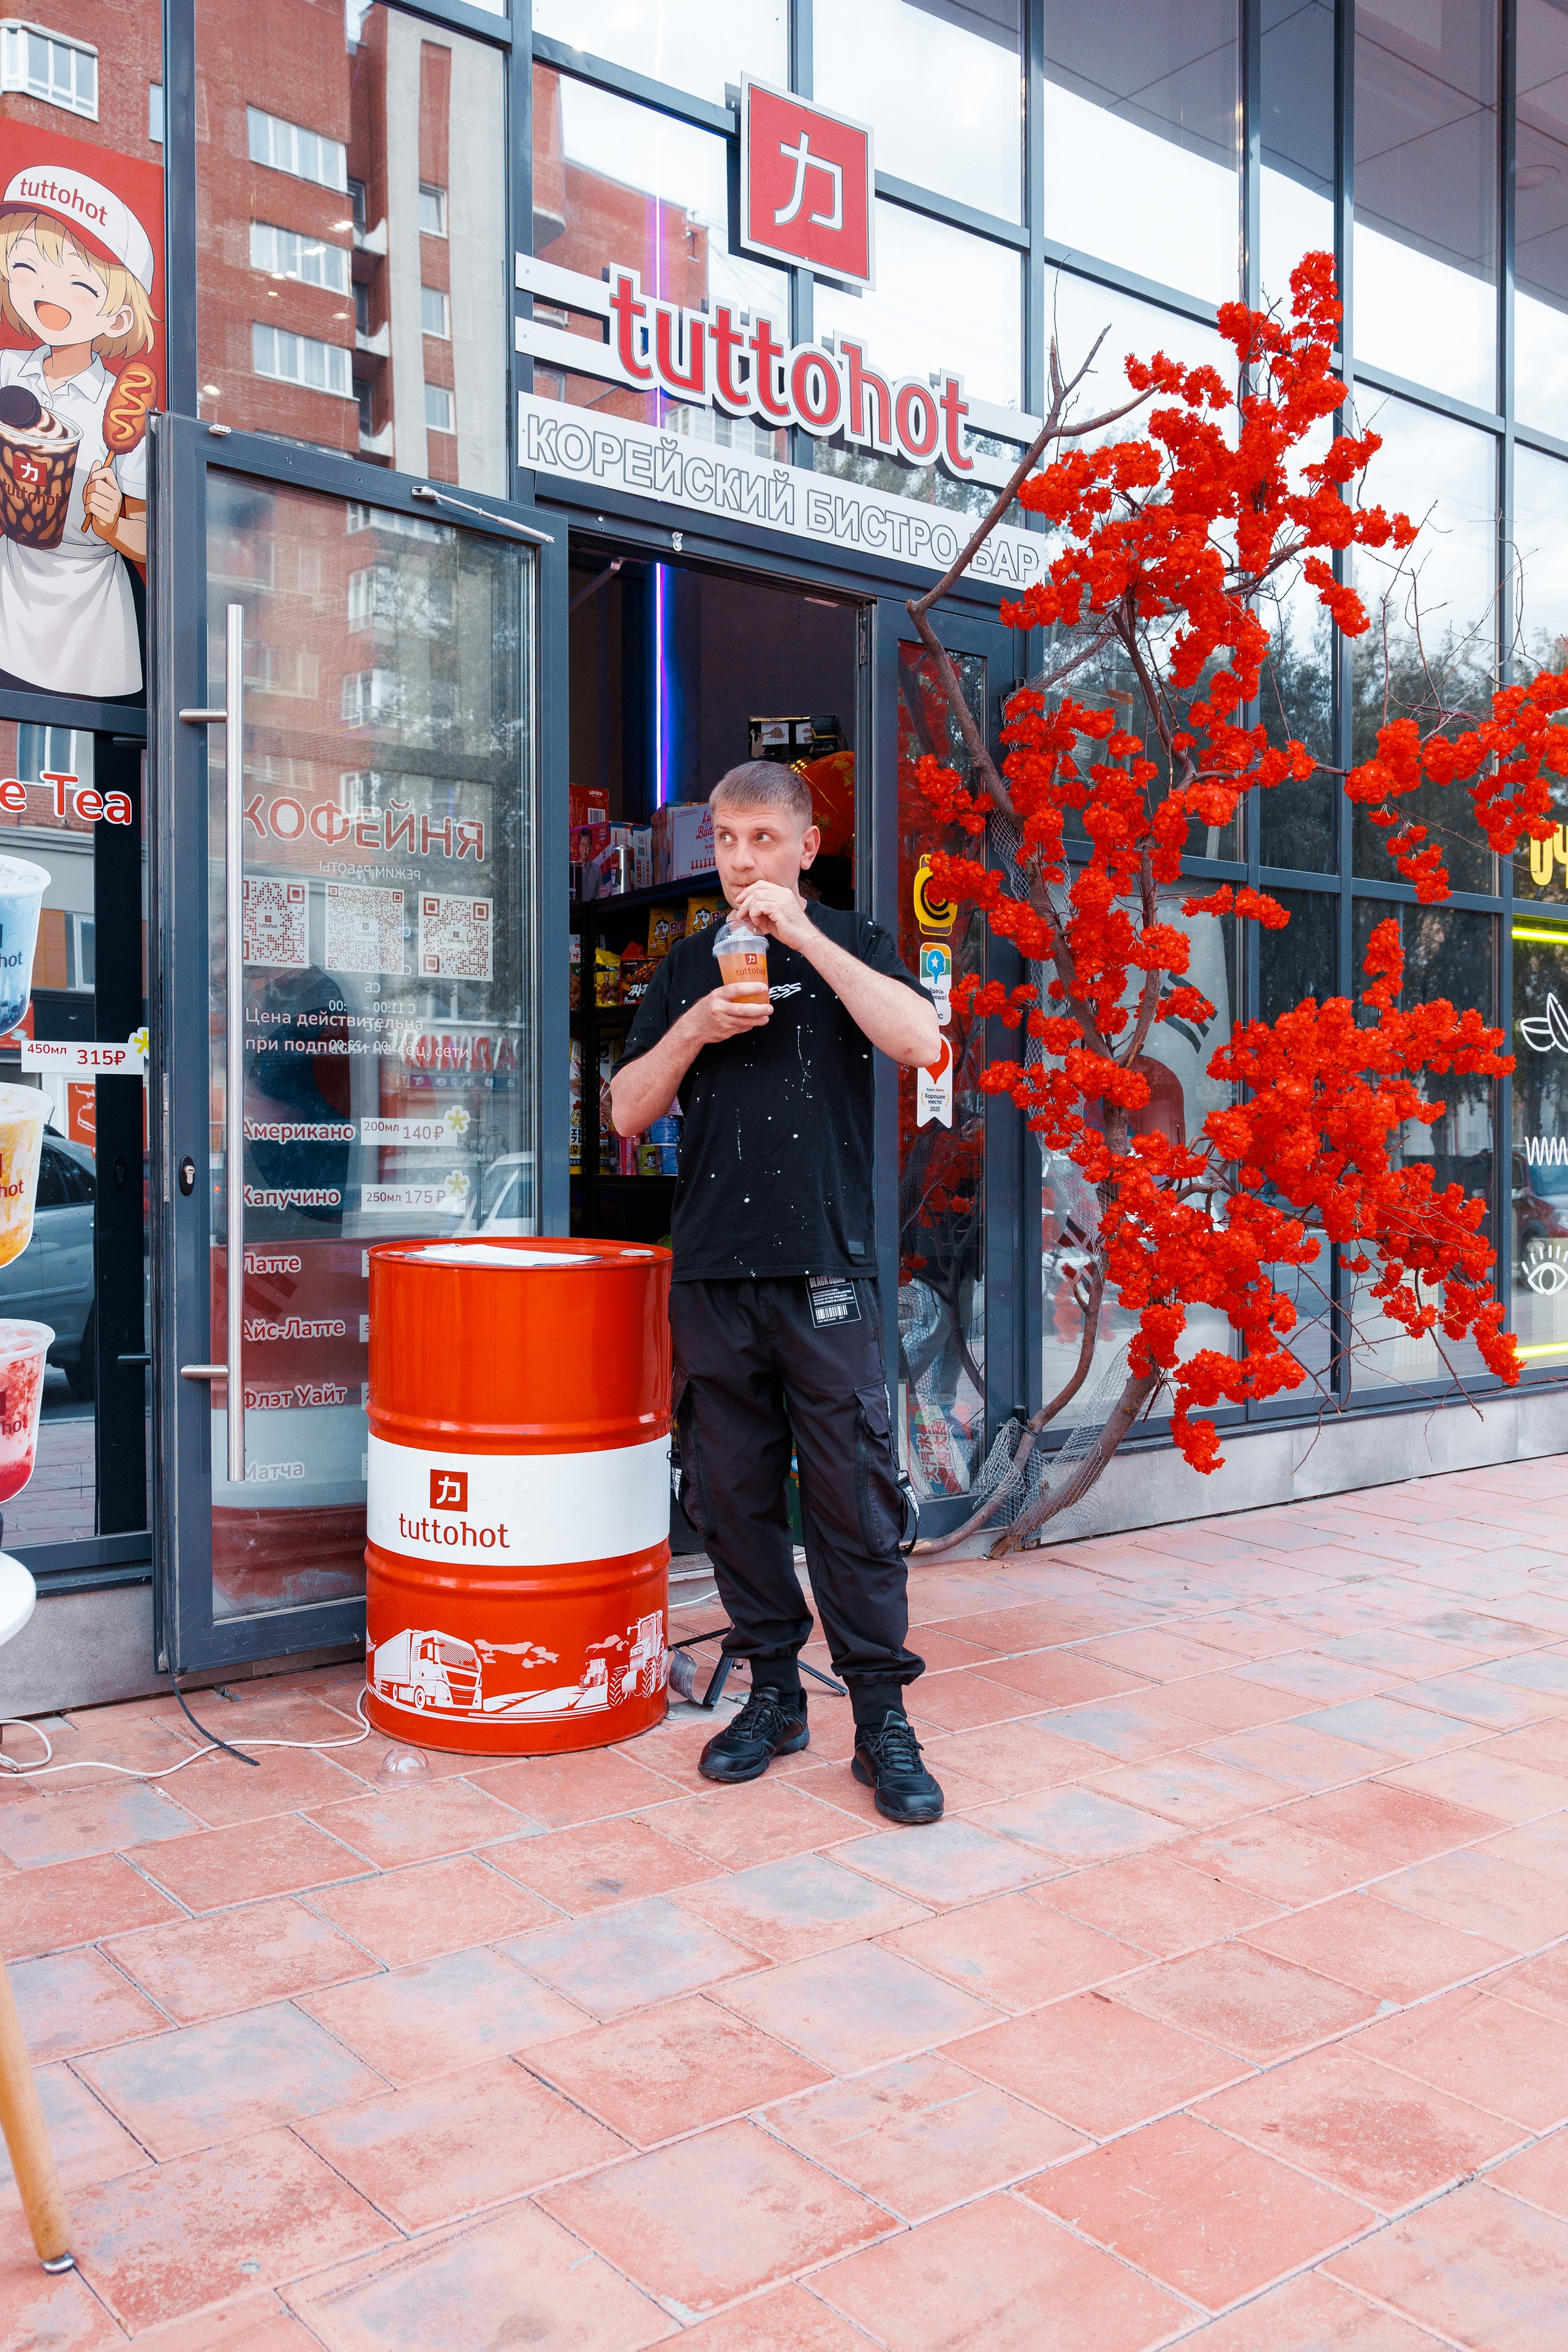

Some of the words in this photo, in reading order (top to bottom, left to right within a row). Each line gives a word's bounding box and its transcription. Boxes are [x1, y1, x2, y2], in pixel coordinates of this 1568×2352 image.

[20, 177, 109, 227] tuttohot
[609, 274, 973, 471] tuttohot
[527, 413, 795, 526] КОРЕЙСКИЙ
[43, 773, 131, 823] Tea
[736, 967, 766, 976] tuttohot
[246, 1007, 291, 1025] Цена
[297, 1011, 423, 1030] действительна
[27, 1043, 67, 1055] 450мл
[77, 1049, 126, 1065] 315₽
[246, 1039, 277, 1054] при
[435, 1046, 469, 1058] сети
[243, 1121, 355, 1143] Американо
[364, 1120, 400, 1132] 200мл
[243, 1187, 340, 1208] Капучино
[366, 1191, 402, 1203] 250мл
[244, 1254, 300, 1272] Латте
[809, 1275, 829, 1288] BLACK
[244, 1319, 345, 1339] Айс-Латте
[245, 1390, 292, 1409] Флэт
[298, 1385, 347, 1404] Уайт
[245, 1463, 303, 1481] Матча
[399, 1513, 510, 1548] tuttohot
